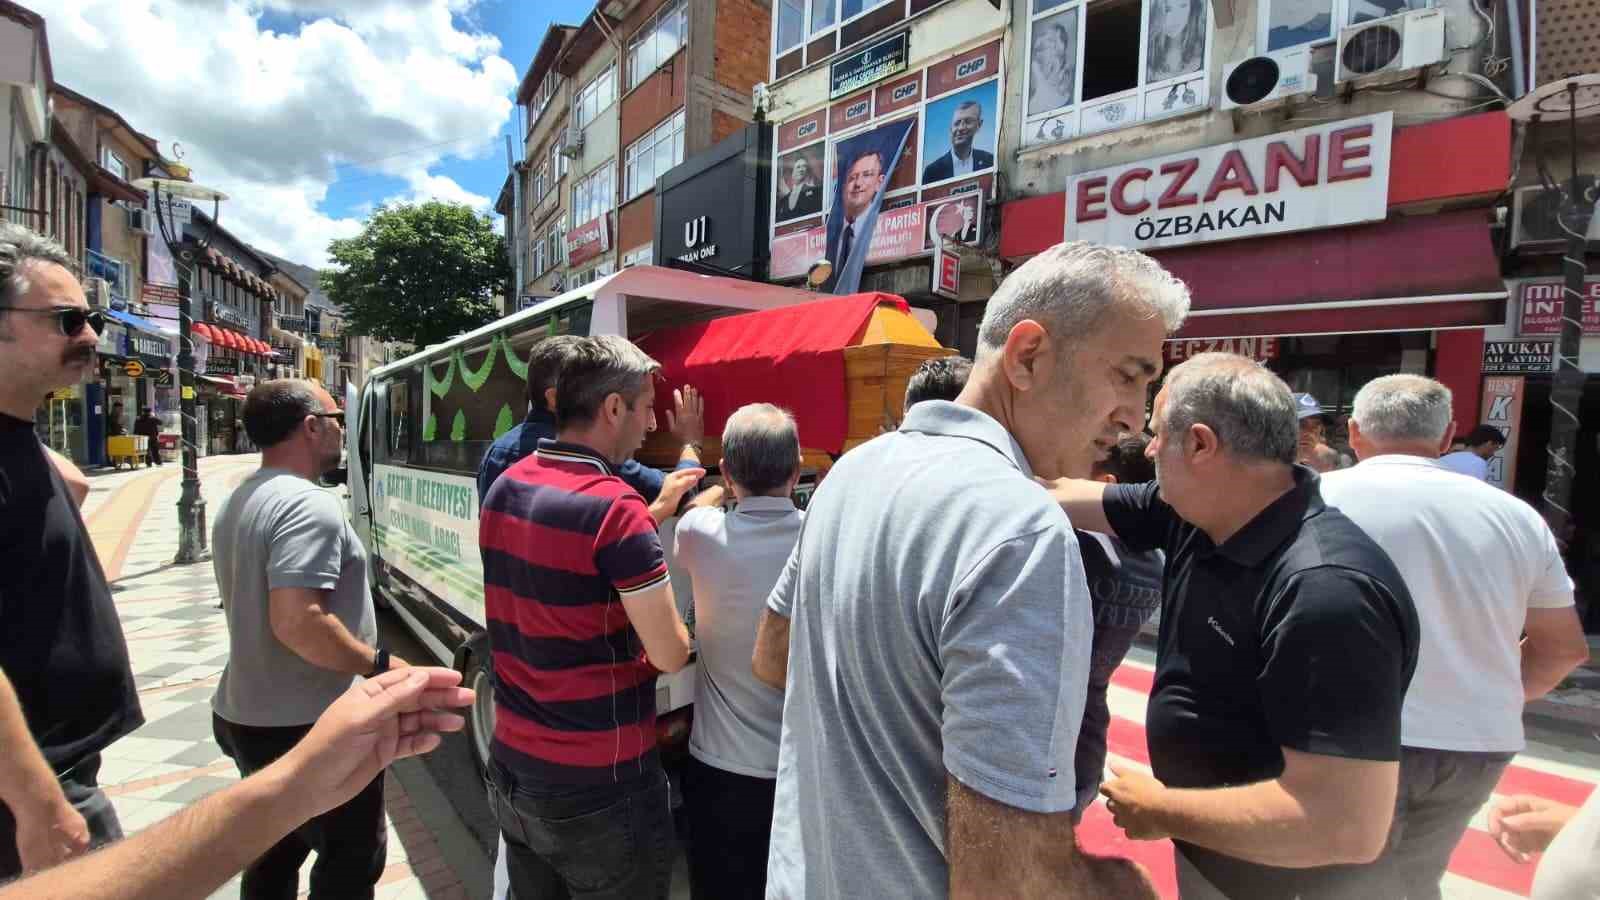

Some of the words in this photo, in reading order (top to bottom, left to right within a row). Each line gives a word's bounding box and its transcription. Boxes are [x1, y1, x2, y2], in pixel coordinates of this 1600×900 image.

[958, 57, 985, 76] CHP
[894, 83, 917, 99] CHP
[847, 103, 867, 117] CHP
[798, 123, 816, 136] CHP
[1076, 124, 1373, 223] ECZANE
[1134, 200, 1286, 241] ÖZBAKAN
[685, 215, 706, 248] U1
[678, 250, 699, 262] RBAN
[700, 245, 716, 259] ONE
[1487, 342, 1552, 354] AVUKAT
[416, 477, 473, 521] BELEDİYESİ
